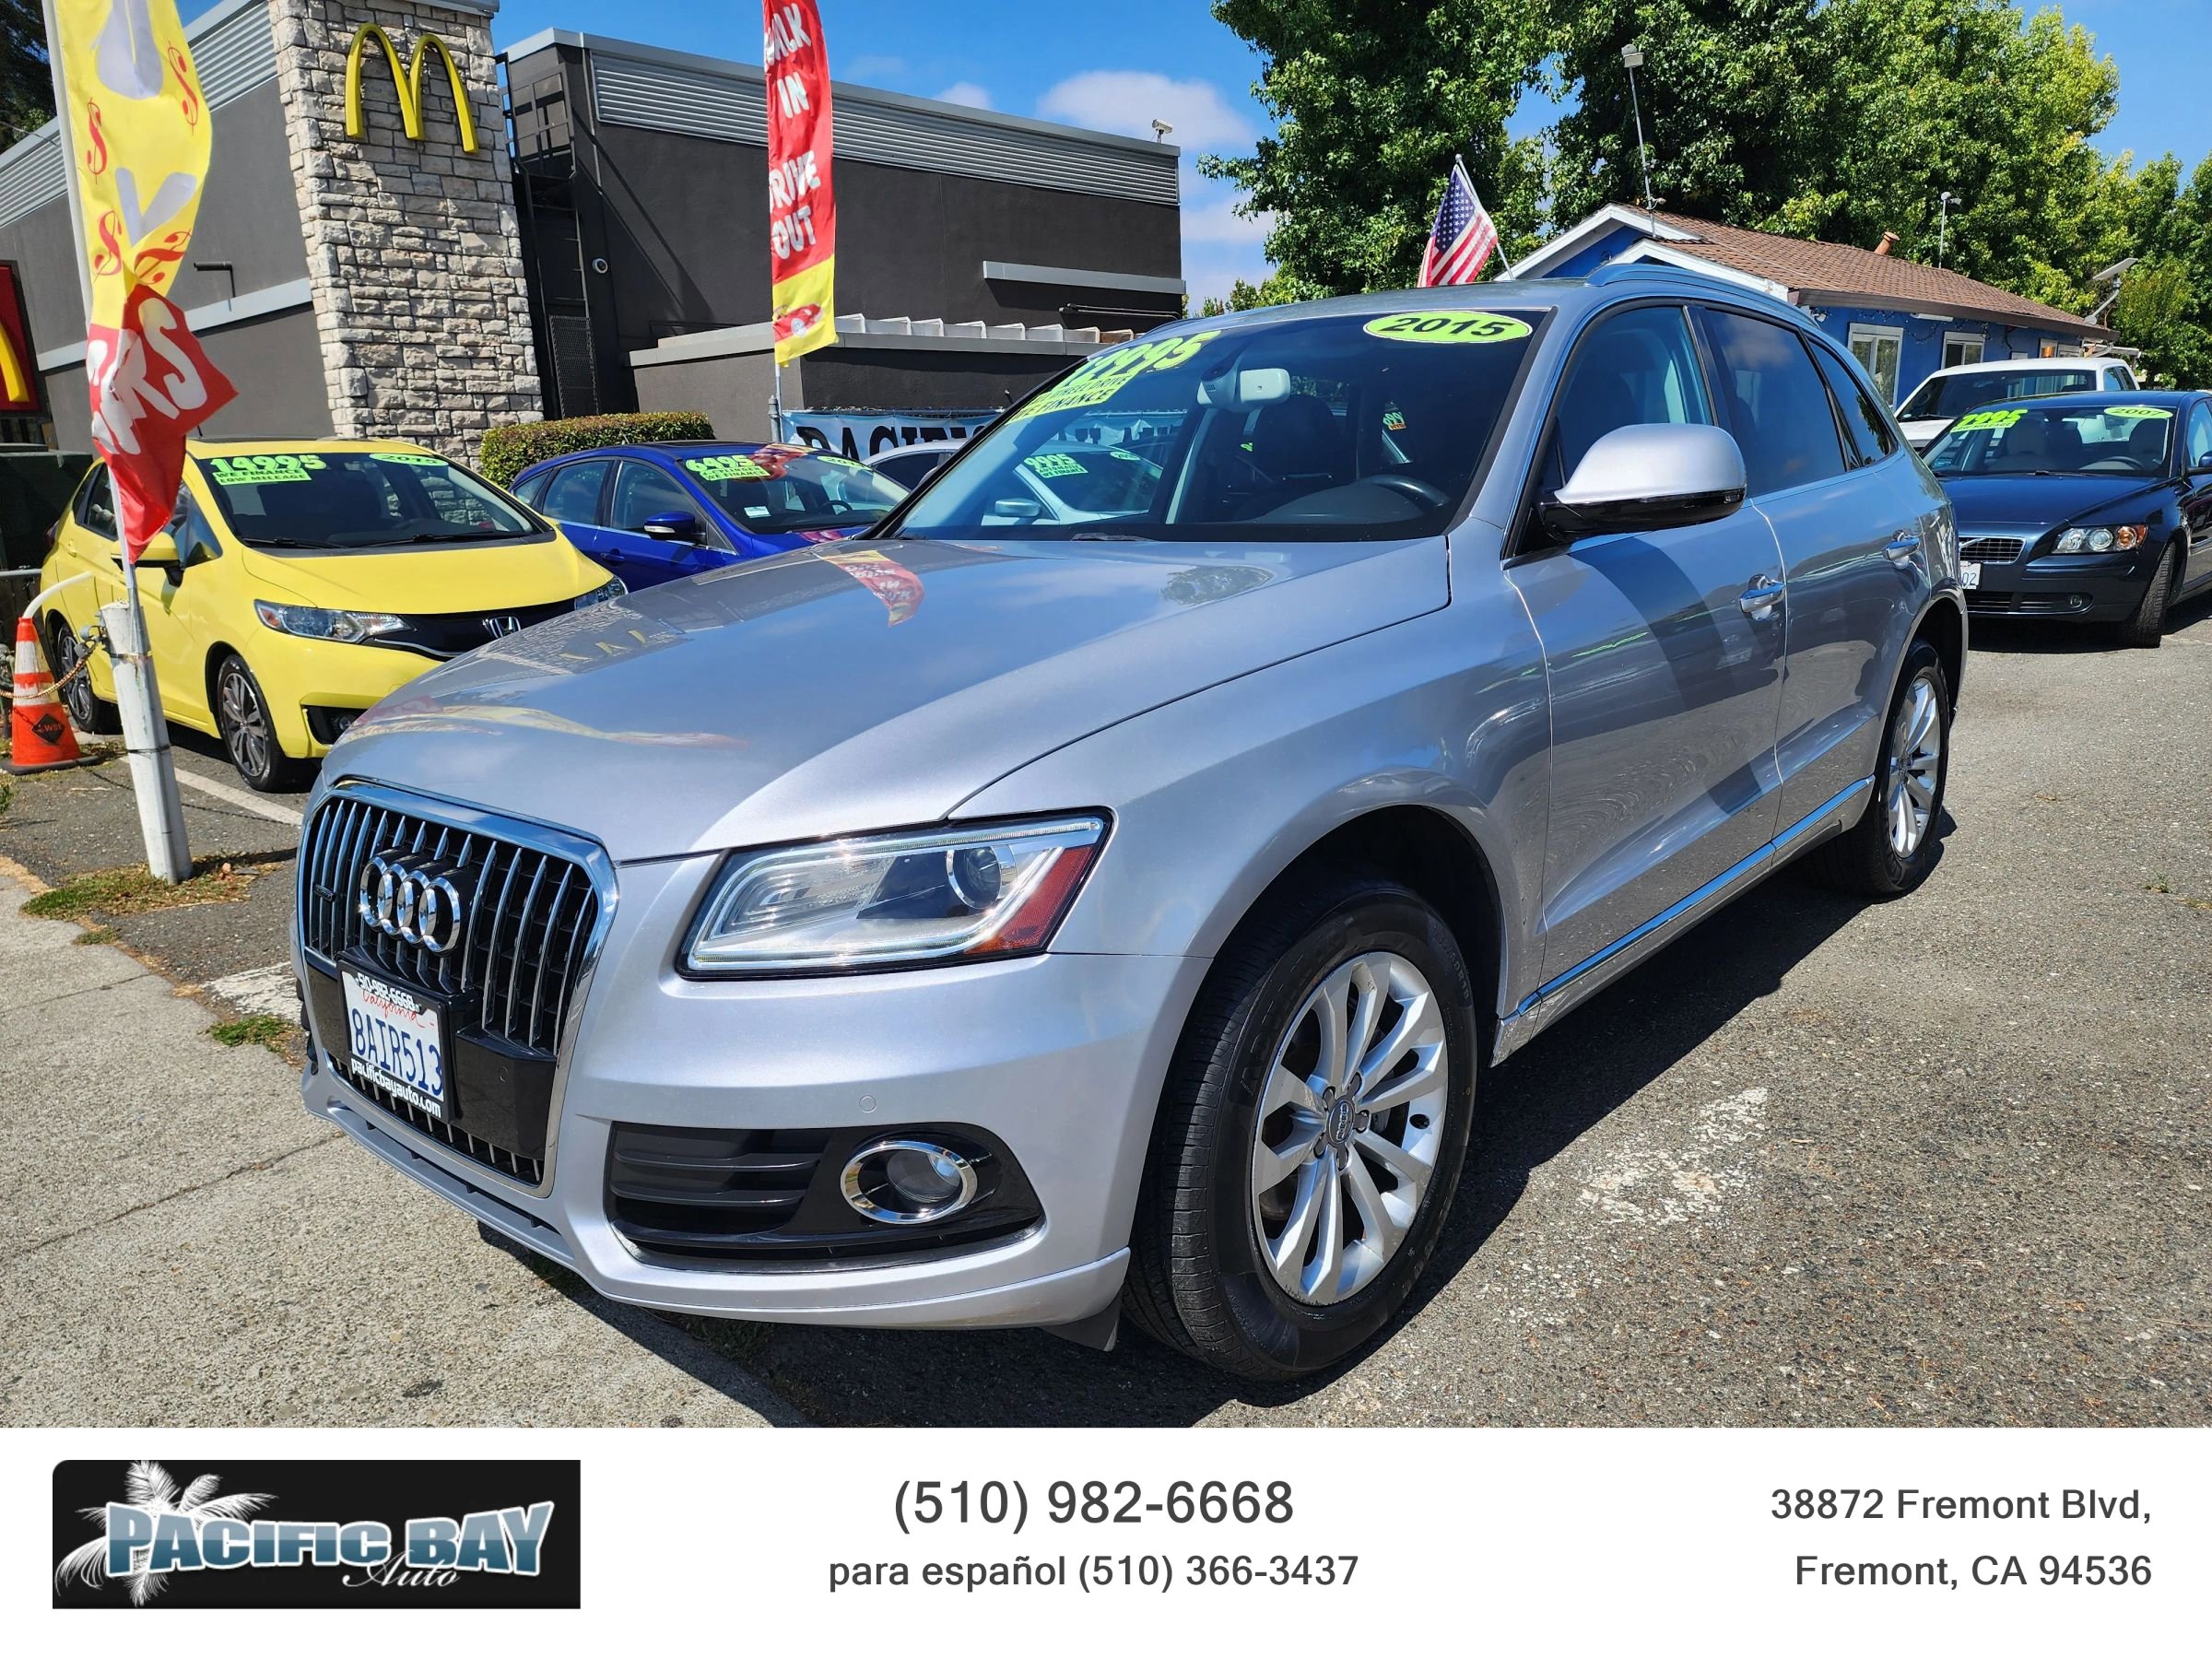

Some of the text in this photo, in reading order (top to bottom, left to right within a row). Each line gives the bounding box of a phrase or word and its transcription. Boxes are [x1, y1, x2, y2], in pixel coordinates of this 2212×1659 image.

[777, 71, 810, 118] IN
[771, 205, 817, 259] OUT
[1378, 318, 1514, 335] 2015
[1033, 388, 1114, 411] FINANCE
[2111, 407, 2166, 417] 2007
[210, 454, 327, 472] 14995
[1024, 453, 1077, 470] 9995
[351, 1007, 443, 1096] 8AIR513
[351, 1057, 441, 1118] pacificbayauto.com
